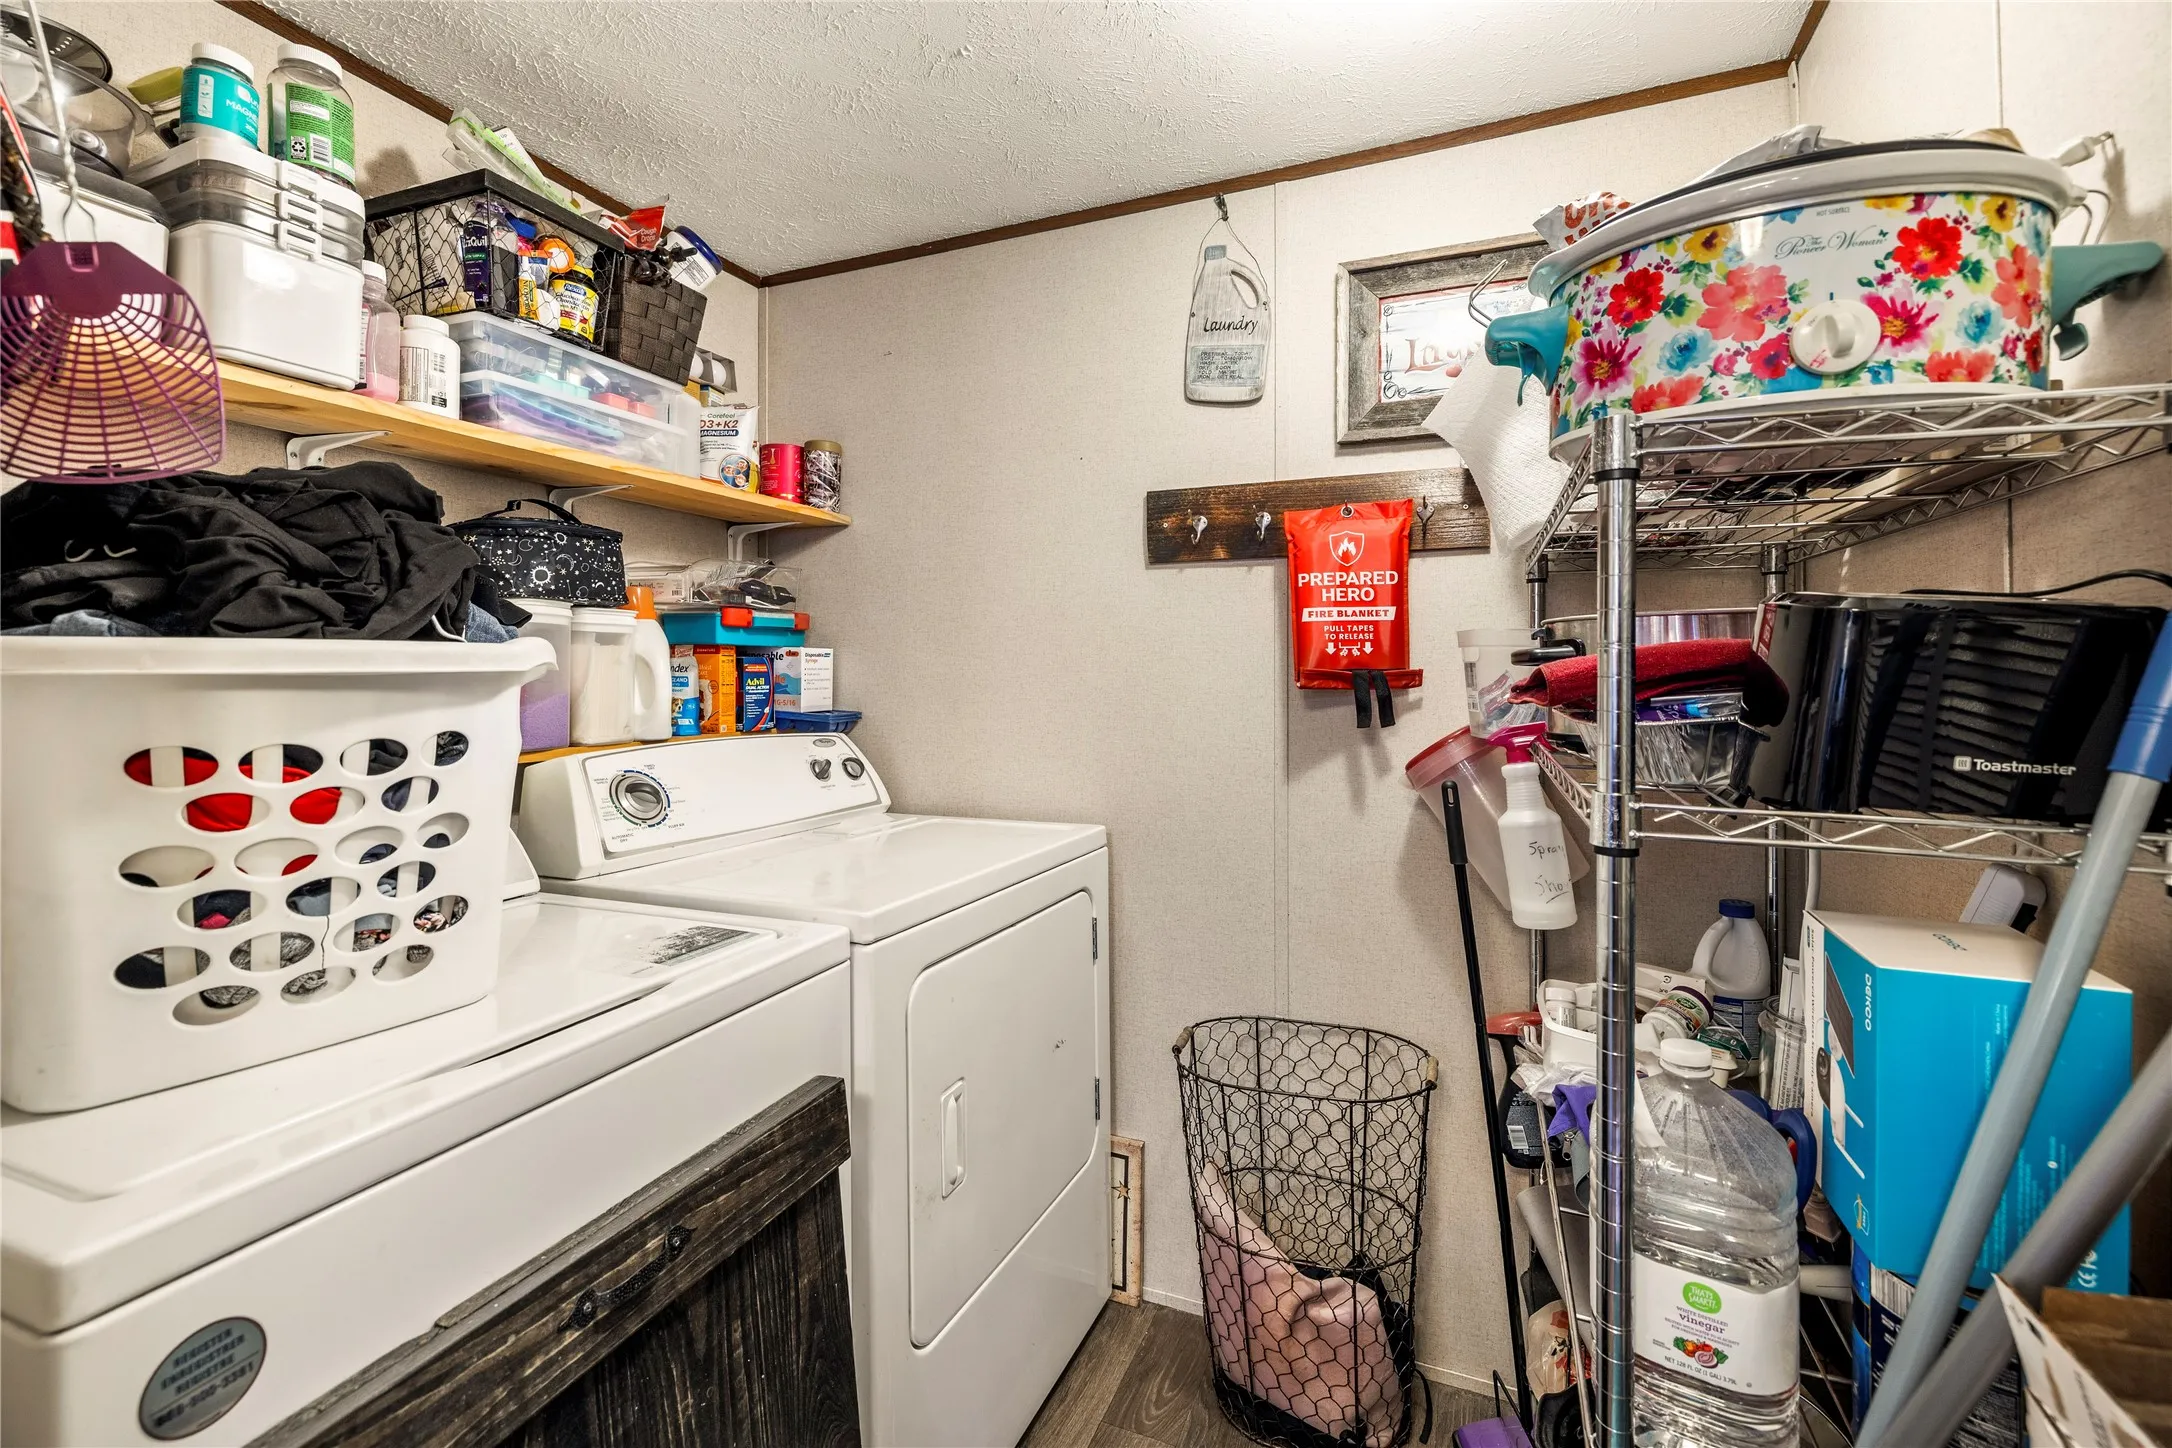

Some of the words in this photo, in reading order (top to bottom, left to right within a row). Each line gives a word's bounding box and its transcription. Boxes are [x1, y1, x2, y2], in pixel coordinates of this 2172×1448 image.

[1774, 236, 1827, 260] Pioneer
[1827, 225, 1884, 251] Woman
[1203, 315, 1259, 336] Laundry
[1297, 570, 1399, 588] PREPARED
[1321, 587, 1375, 602] HERO
[1307, 610, 1334, 618] FIRE
[1336, 609, 1390, 618] BLANKET
[1347, 624, 1374, 632] TAPES
[745, 677, 765, 686] Advil
[1973, 758, 2077, 776] Toastmaster
[1678, 1312, 1726, 1334] vinegar
[1664, 1355, 1675, 1364] NET
[1676, 1360, 1687, 1369] 128
[1694, 1366, 1702, 1374] OZ
[1708, 1371, 1722, 1381] GAL)
